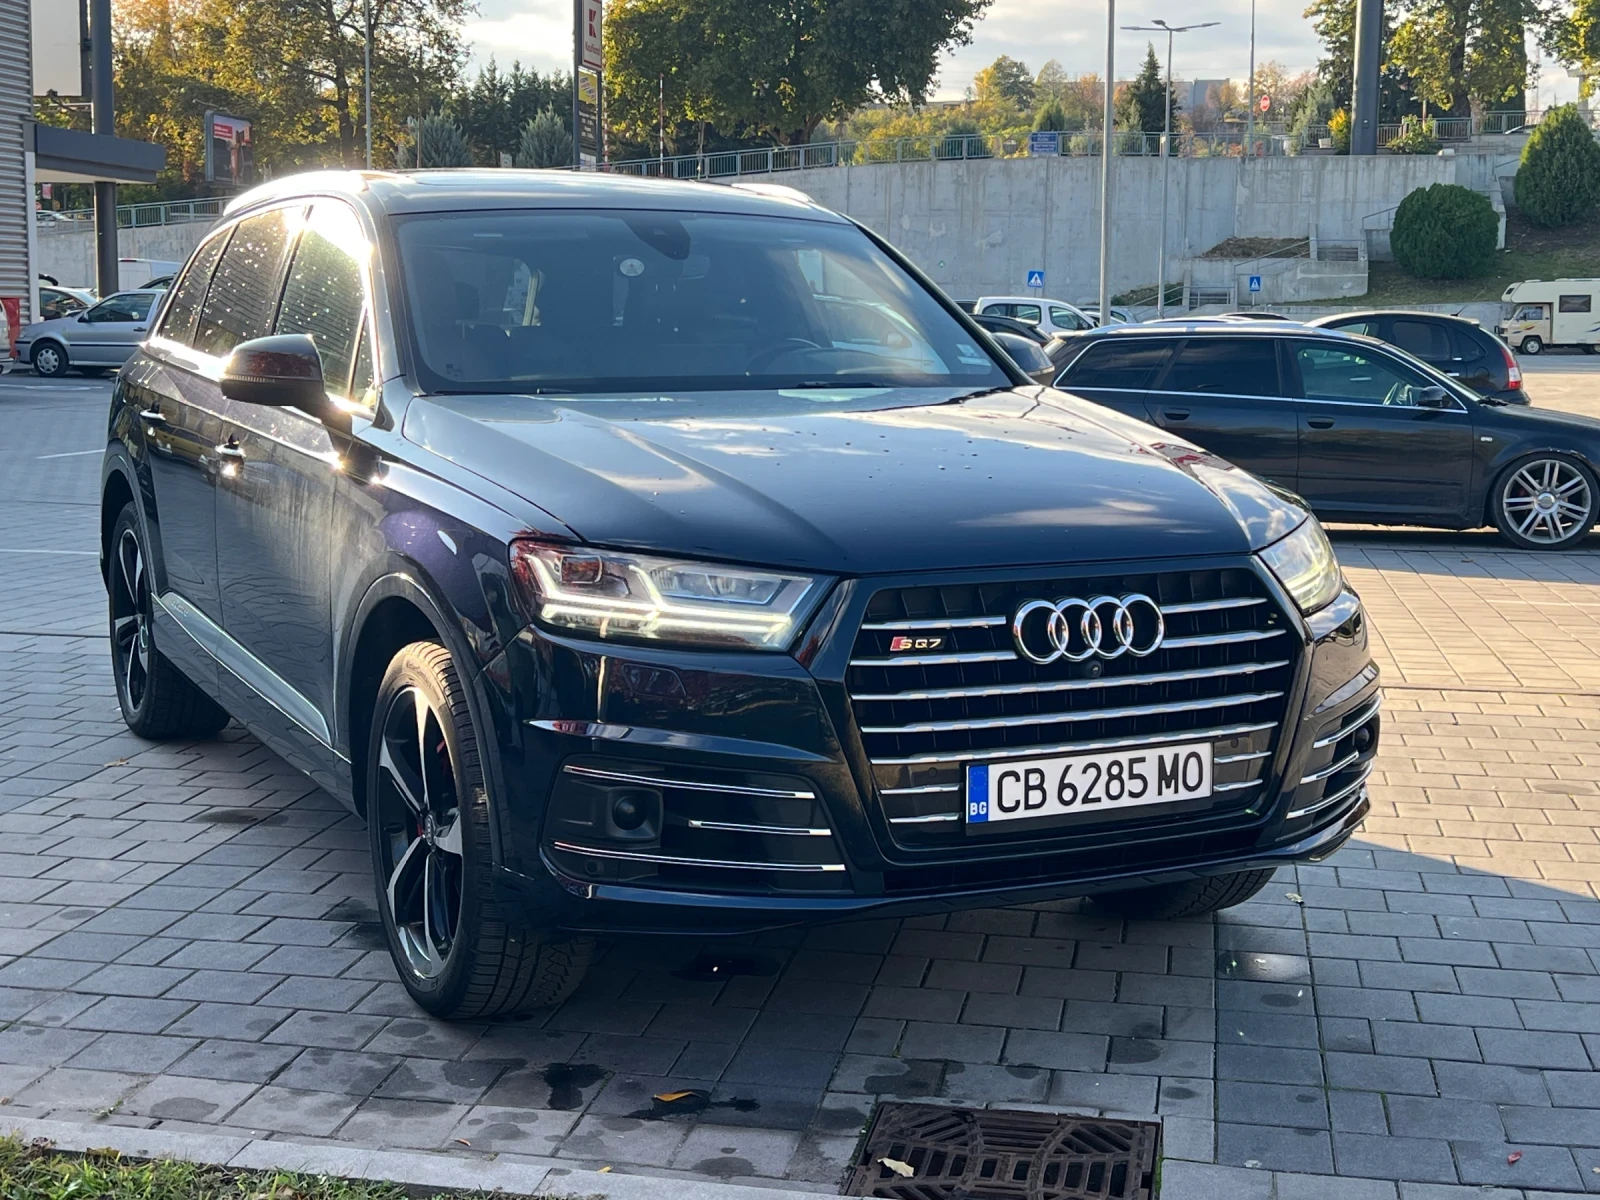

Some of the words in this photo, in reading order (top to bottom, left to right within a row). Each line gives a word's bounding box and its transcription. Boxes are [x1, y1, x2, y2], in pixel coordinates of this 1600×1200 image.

[897, 637, 942, 650] SQ7
[997, 767, 1047, 813] CB
[1057, 756, 1149, 807] 6285
[1157, 751, 1204, 796] MO
[969, 802, 987, 816] BG
